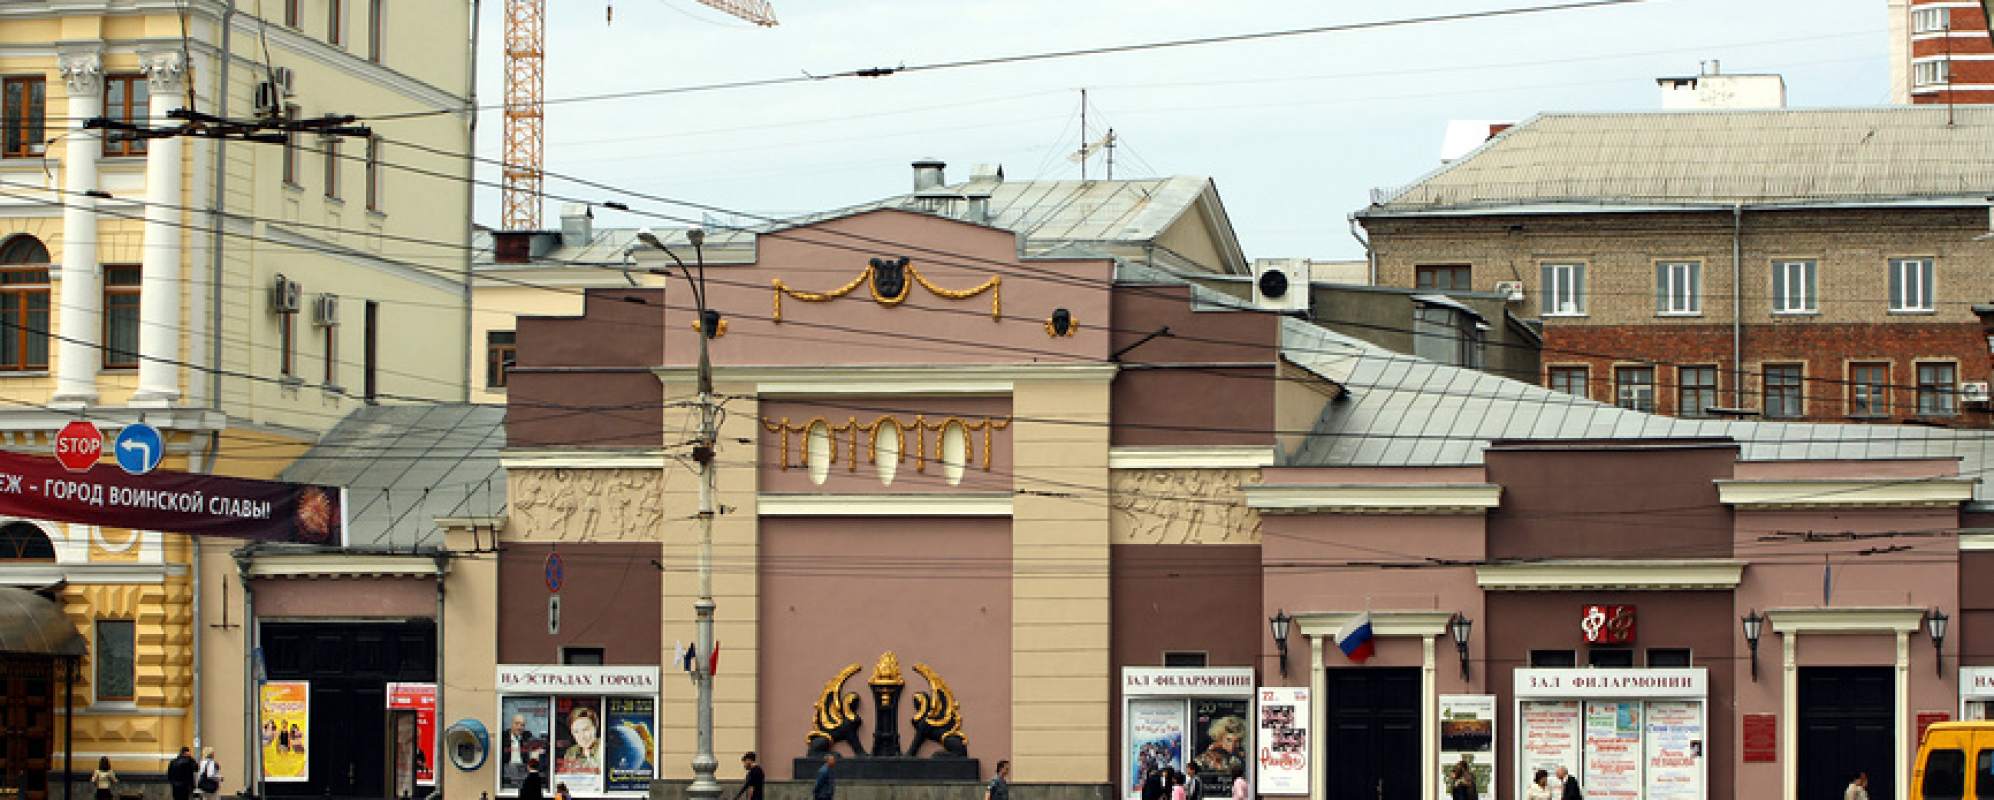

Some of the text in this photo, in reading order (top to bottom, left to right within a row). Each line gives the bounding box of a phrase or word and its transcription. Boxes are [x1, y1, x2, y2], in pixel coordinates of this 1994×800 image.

[59, 438, 100, 455] STOP
[44, 479, 104, 507] ГОРОД
[109, 485, 204, 513] ВОИНСКОЙ
[209, 496, 271, 519] СЛАВЫ!
[600, 674, 652, 686] ГОРОДА
[1127, 675, 1251, 686] ЗАЛ ФИЛАРМОНИИ
[1529, 676, 1693, 688] ЗАЛ ФИЛАРМОНИИ
